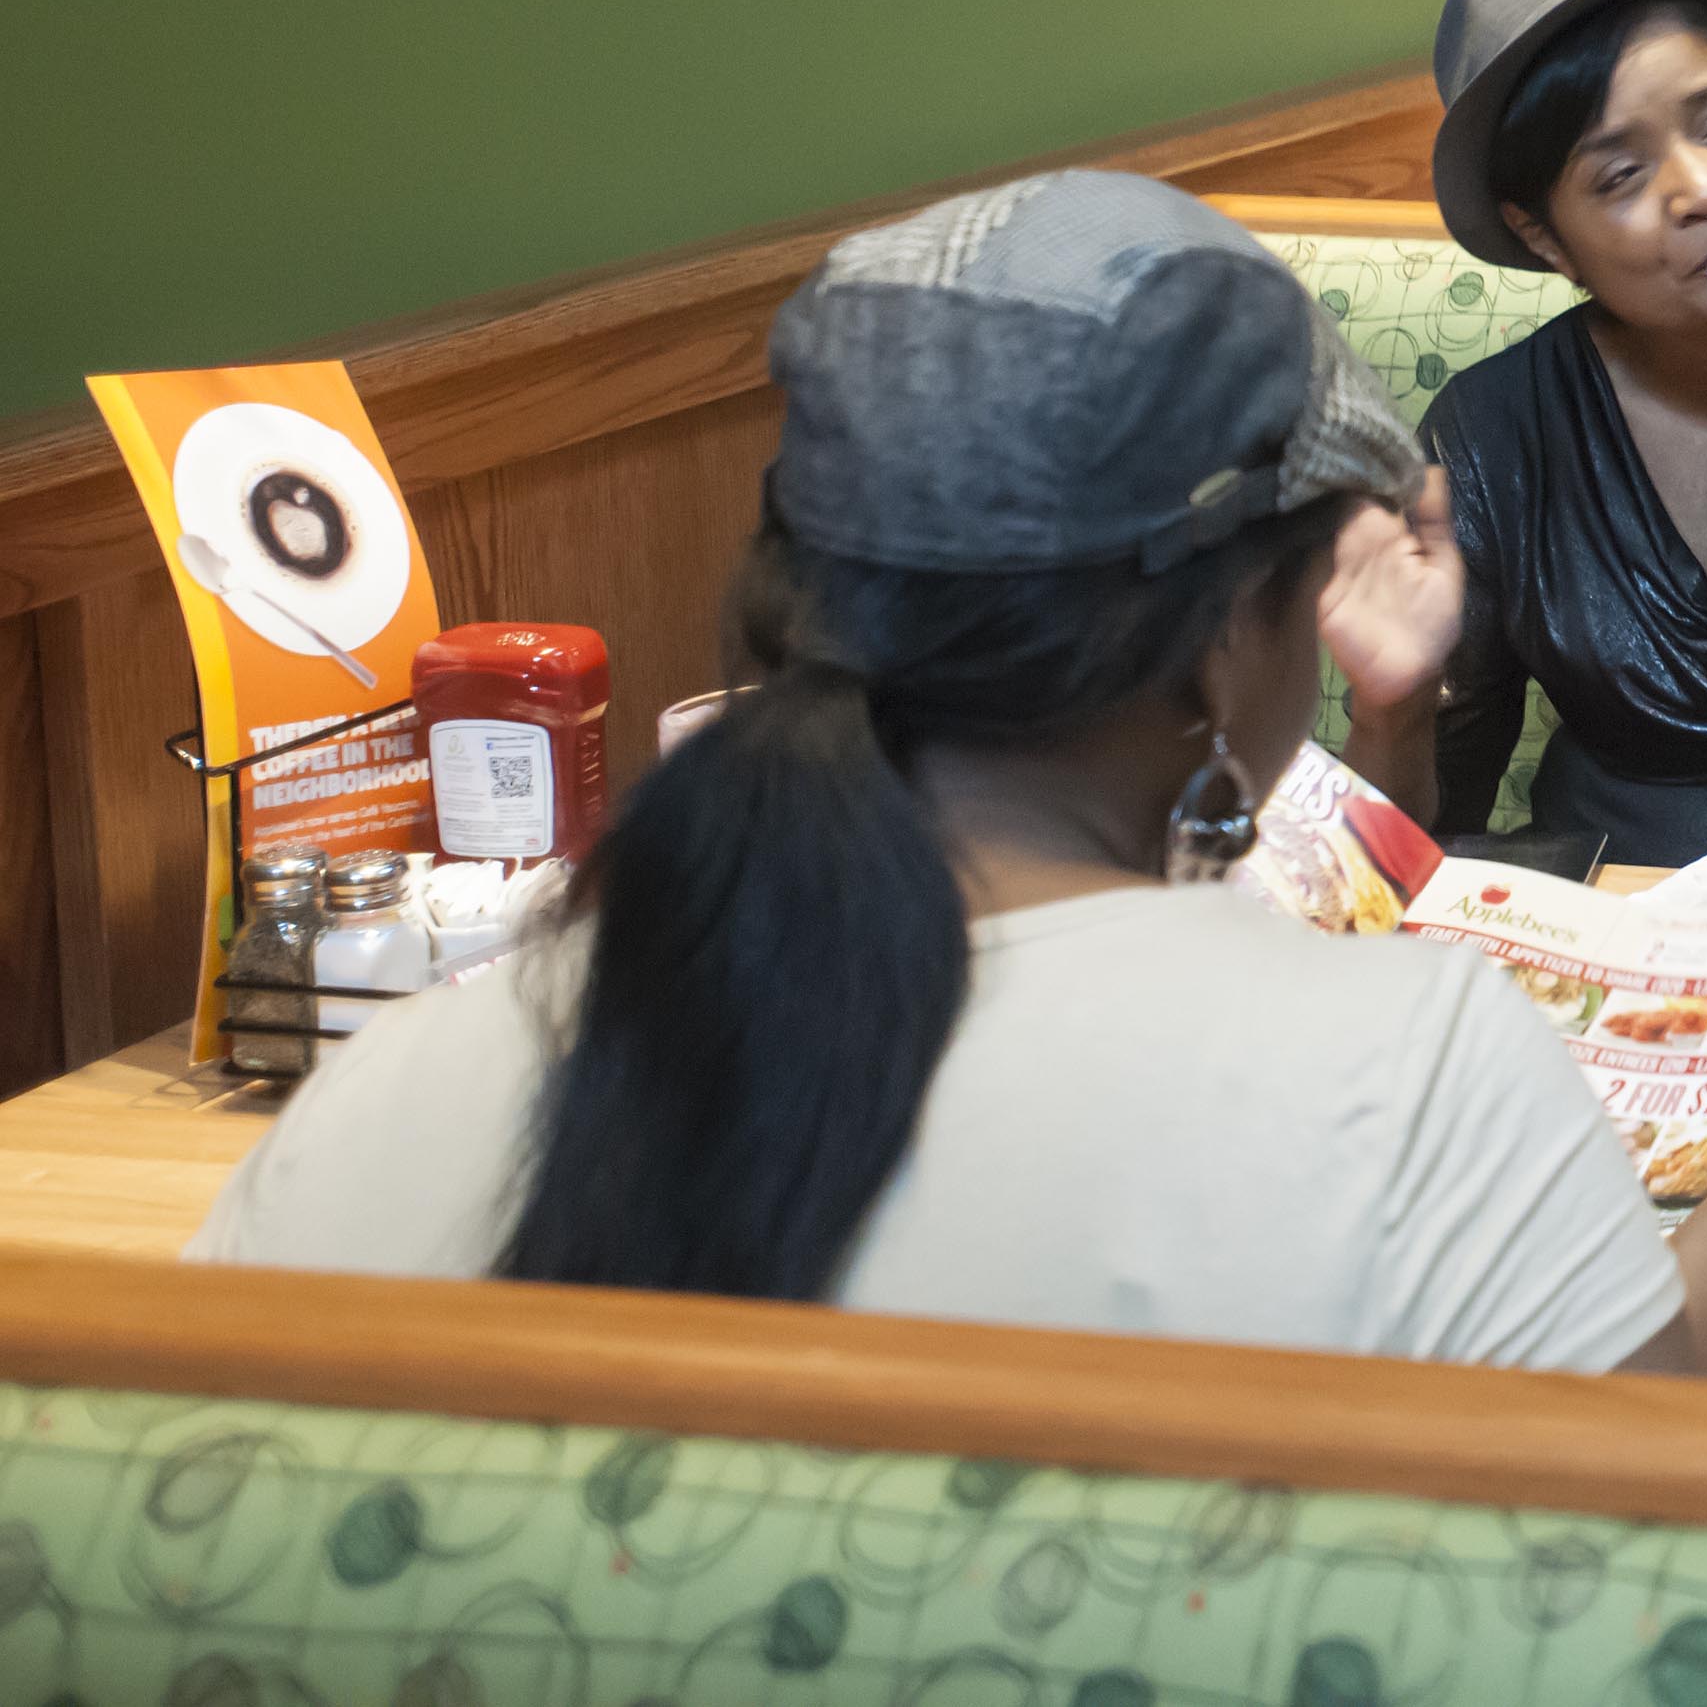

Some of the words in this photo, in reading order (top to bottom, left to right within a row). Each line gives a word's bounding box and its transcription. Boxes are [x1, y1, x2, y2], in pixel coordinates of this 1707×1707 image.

[250, 744, 340, 781] COFFEE
[341, 740, 367, 766] IN
[369, 732, 415, 760] THE
[1416, 924, 1465, 943] START
[1507, 944, 1585, 978] APPETIZER
[1602, 1078, 1627, 1112] 2
[1625, 1081, 1687, 1116] FOR
